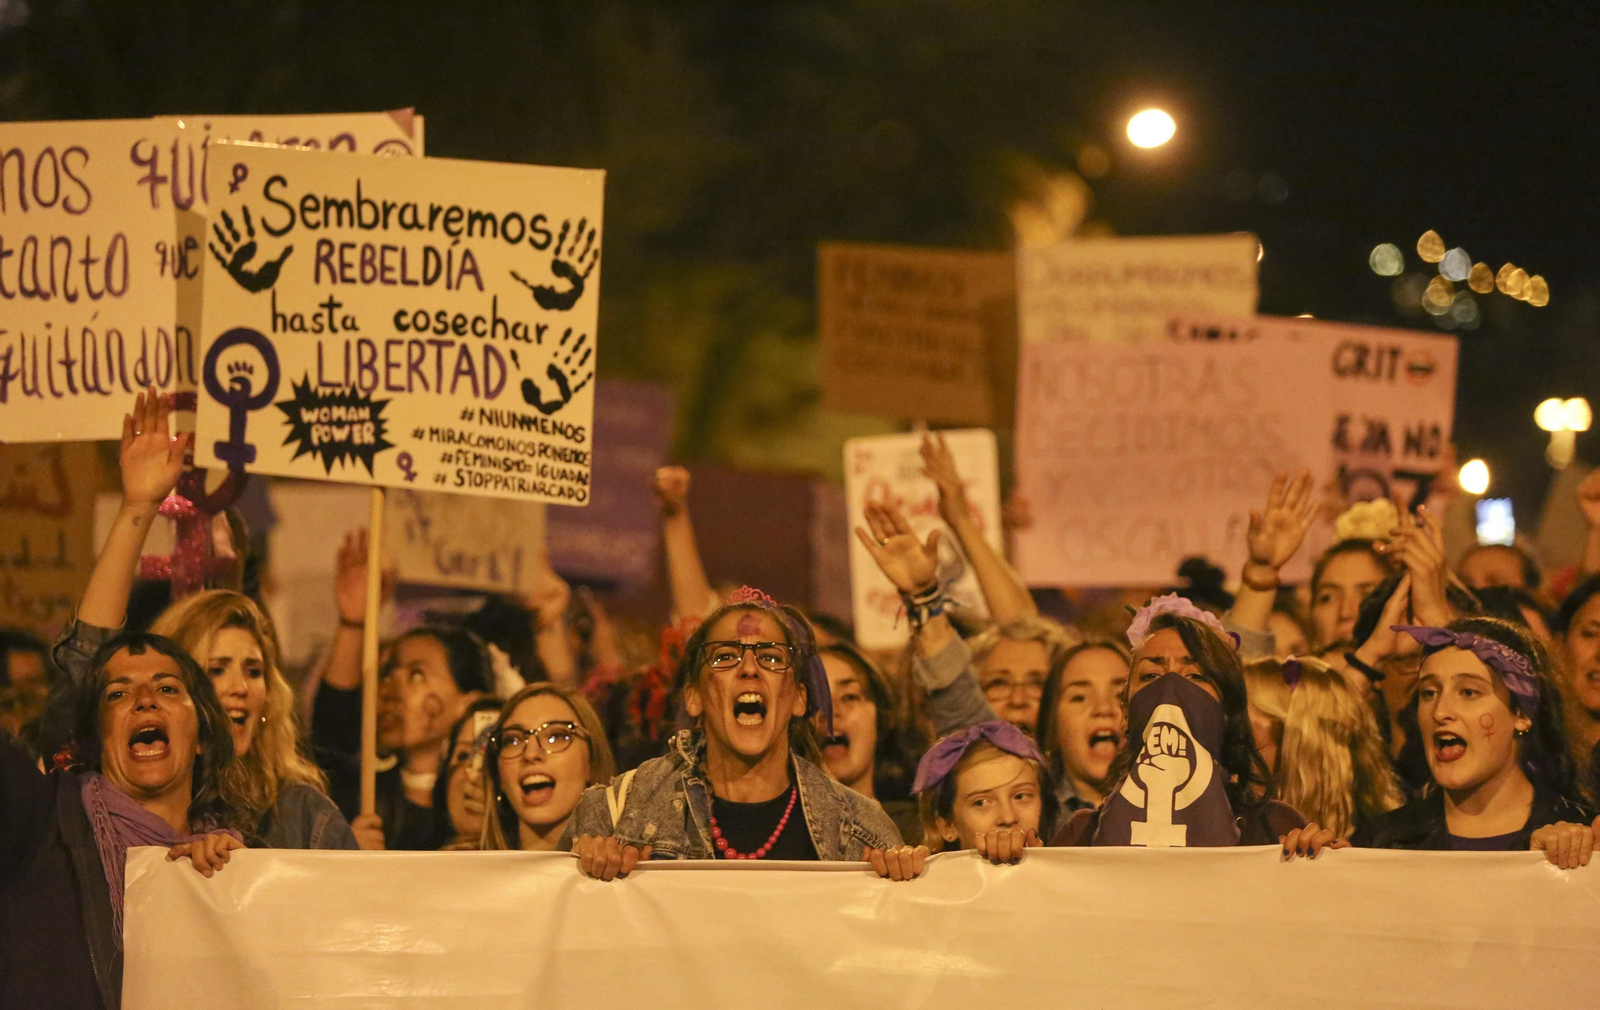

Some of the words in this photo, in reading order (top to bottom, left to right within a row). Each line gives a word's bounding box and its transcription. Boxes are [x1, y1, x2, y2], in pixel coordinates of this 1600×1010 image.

[261, 175, 553, 250] Sembraremos
[0, 231, 128, 303] tanto
[155, 235, 199, 280] que
[314, 237, 485, 291] REBELDÍA
[271, 289, 360, 333] hasta
[393, 294, 550, 345] cosechar
[317, 338, 508, 400] LIBERTAD
[300, 405, 371, 423] WOMAN
[311, 421, 376, 446] POWER
